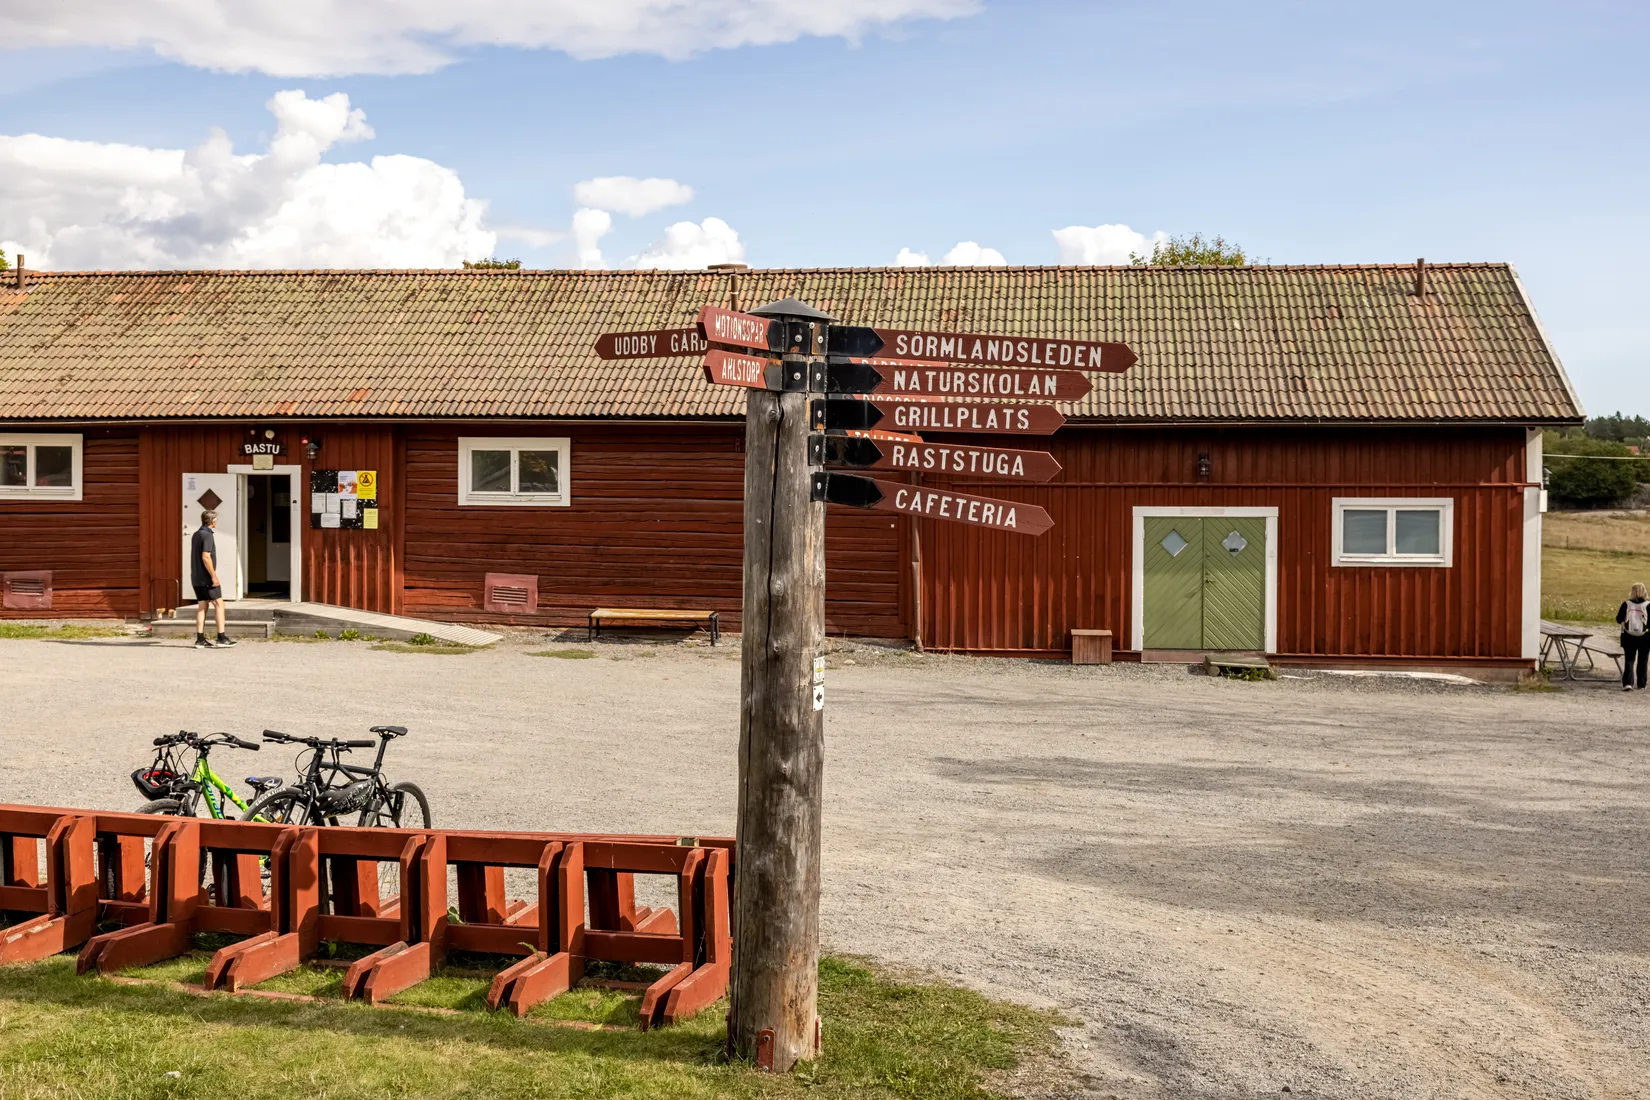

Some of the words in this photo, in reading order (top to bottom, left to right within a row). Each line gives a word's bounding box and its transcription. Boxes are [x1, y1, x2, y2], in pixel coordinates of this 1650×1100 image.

[715, 313, 764, 344] MOTIONSSPÅR
[614, 335, 657, 356] UDDBY
[896, 332, 1102, 368] SÖRMLANDSLEDEN
[721, 357, 761, 383] AHLSTORP
[893, 370, 1058, 396] NATURSKOLAN
[894, 405, 1030, 430] GRILLPLATS
[244, 443, 280, 455] BASTU
[892, 445, 1024, 476] RASTSTUGA
[895, 488, 1017, 529] CAFETERIA
